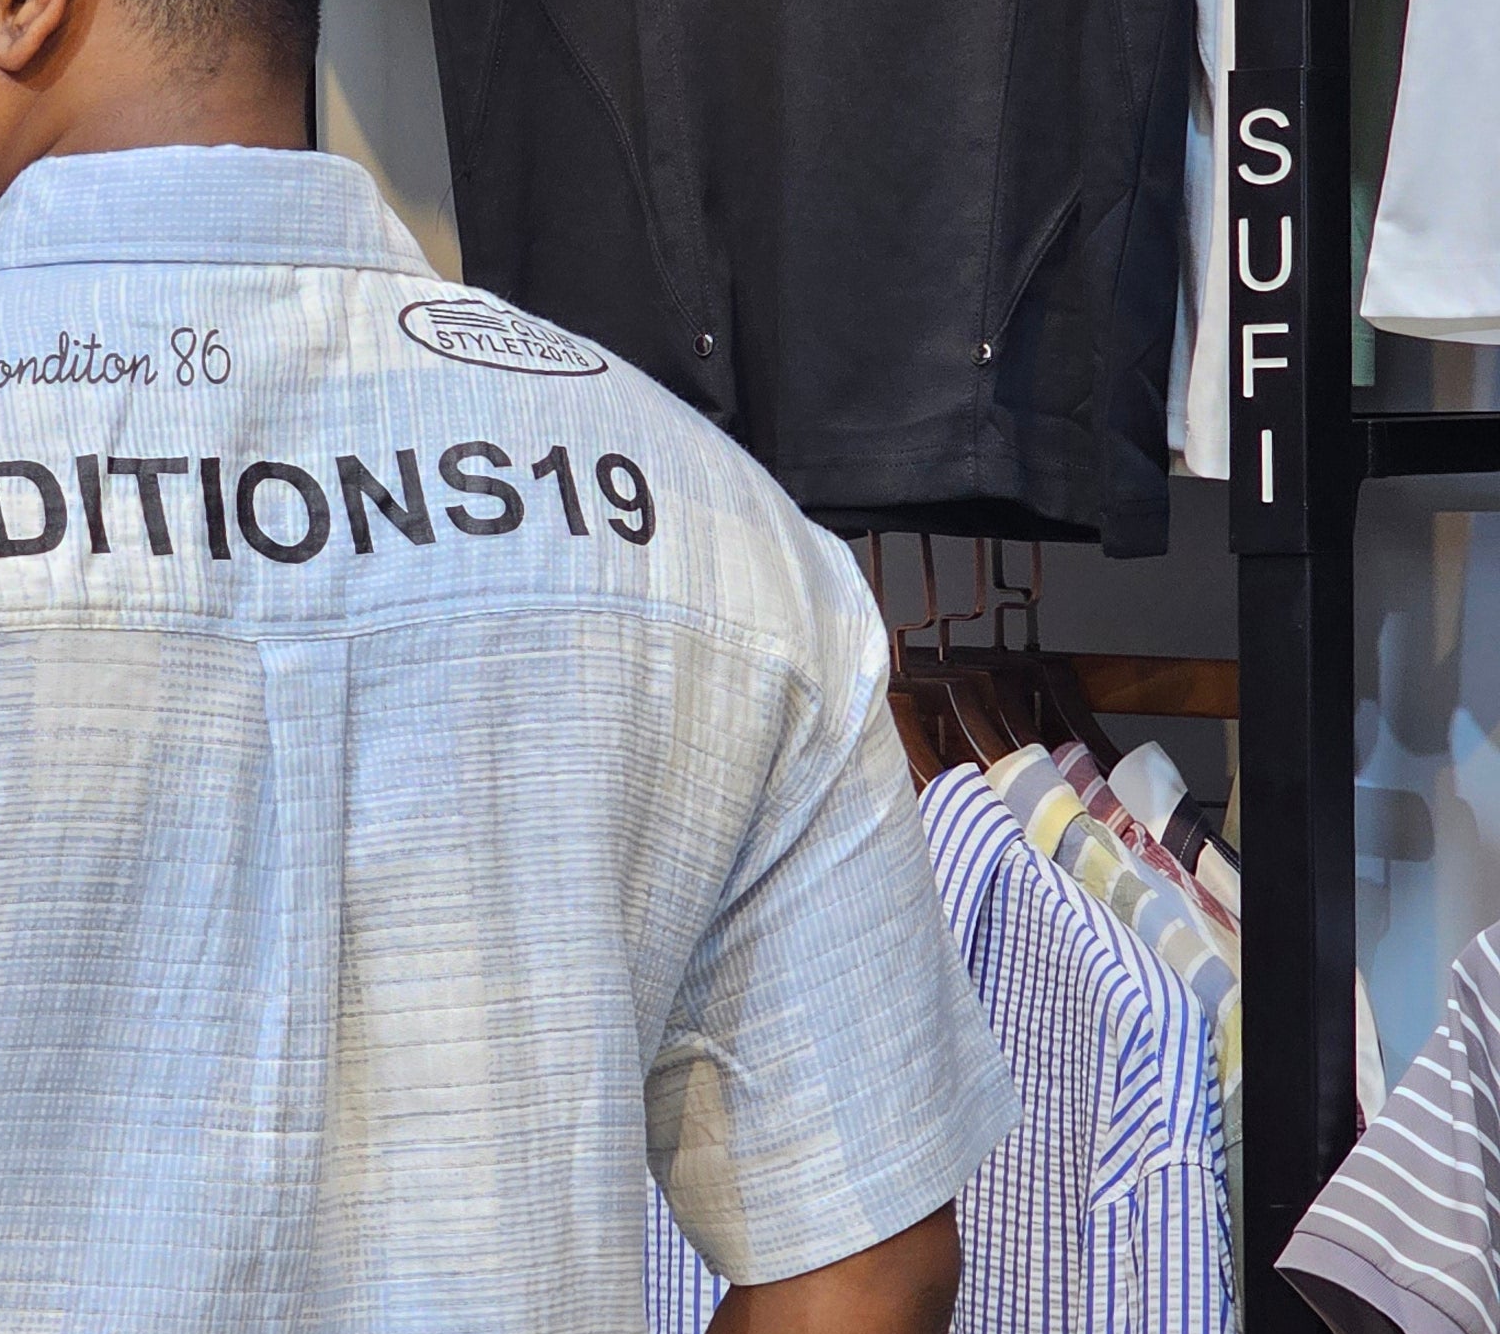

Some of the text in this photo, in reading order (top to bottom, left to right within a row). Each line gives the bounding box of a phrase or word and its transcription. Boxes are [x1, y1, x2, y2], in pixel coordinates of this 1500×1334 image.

[1237, 107, 1293, 504] SUFI
[170, 327, 232, 386] 86
[436, 330, 590, 367] STYLET2018
[510, 320, 577, 350] CLUB
